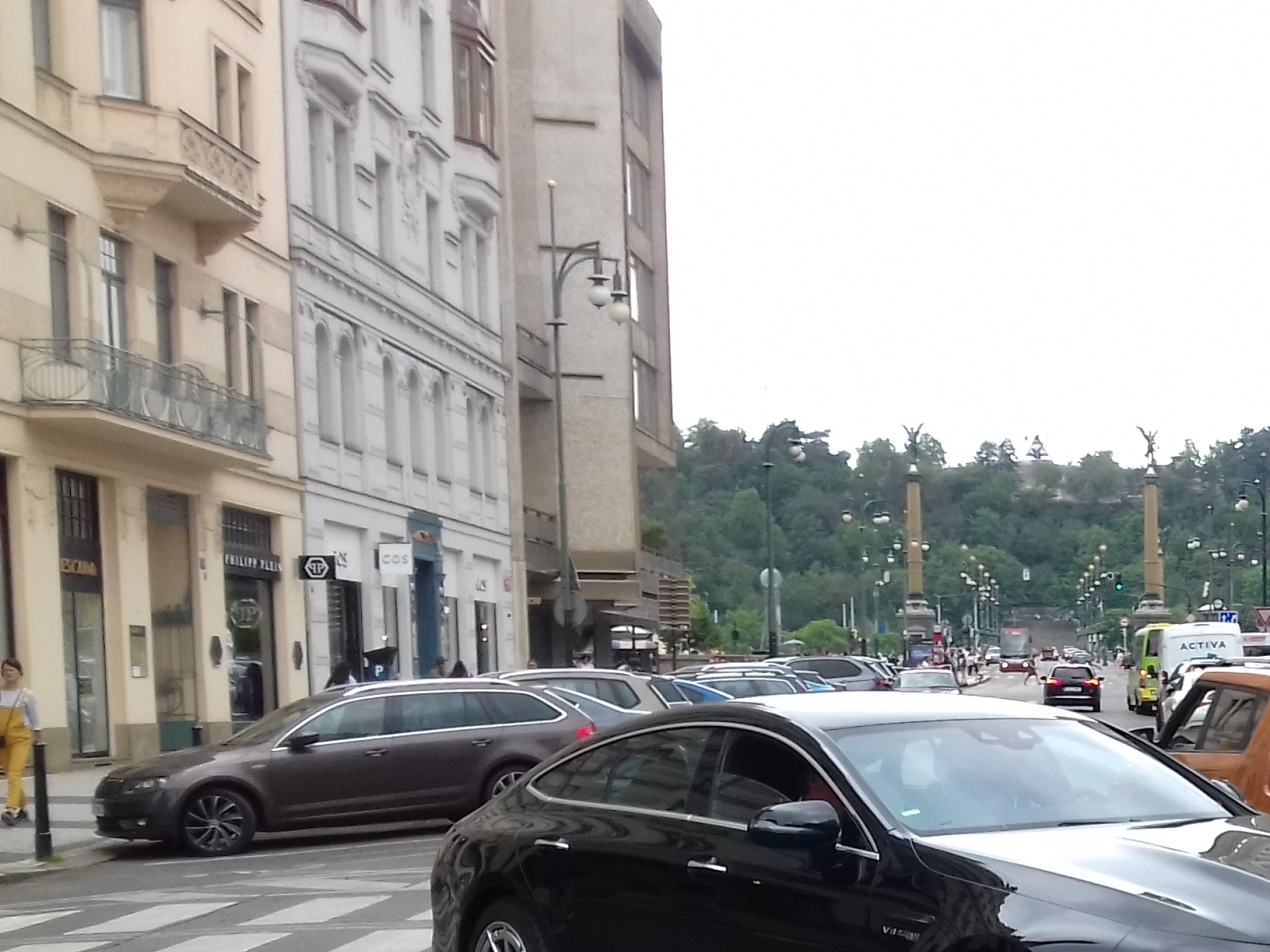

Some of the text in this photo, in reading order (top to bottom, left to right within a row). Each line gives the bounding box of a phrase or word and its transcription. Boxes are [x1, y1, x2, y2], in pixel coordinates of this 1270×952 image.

[382, 553, 409, 564] COS
[1180, 640, 1227, 651] ACTIVA
[375, 665, 384, 677] P
